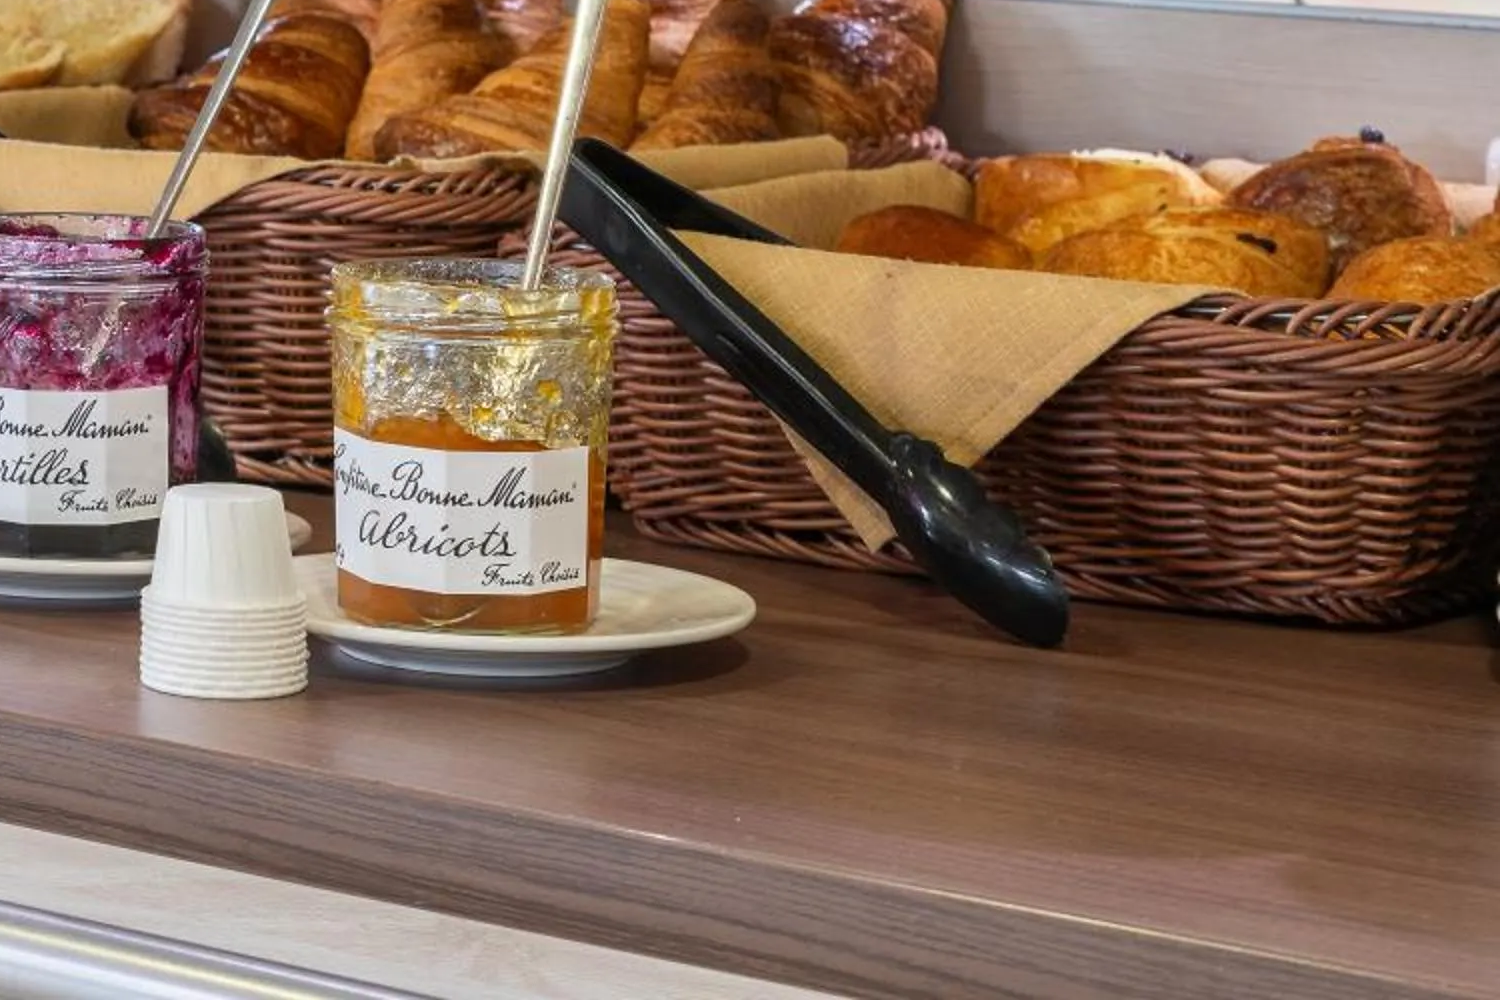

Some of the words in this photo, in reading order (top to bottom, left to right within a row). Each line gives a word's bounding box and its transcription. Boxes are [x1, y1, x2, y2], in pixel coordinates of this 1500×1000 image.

[335, 444, 386, 496] nfiture
[389, 459, 472, 507] Bonne
[57, 489, 109, 513] Fruits
[359, 509, 517, 559] Abricots
[481, 563, 534, 587] Fruits
